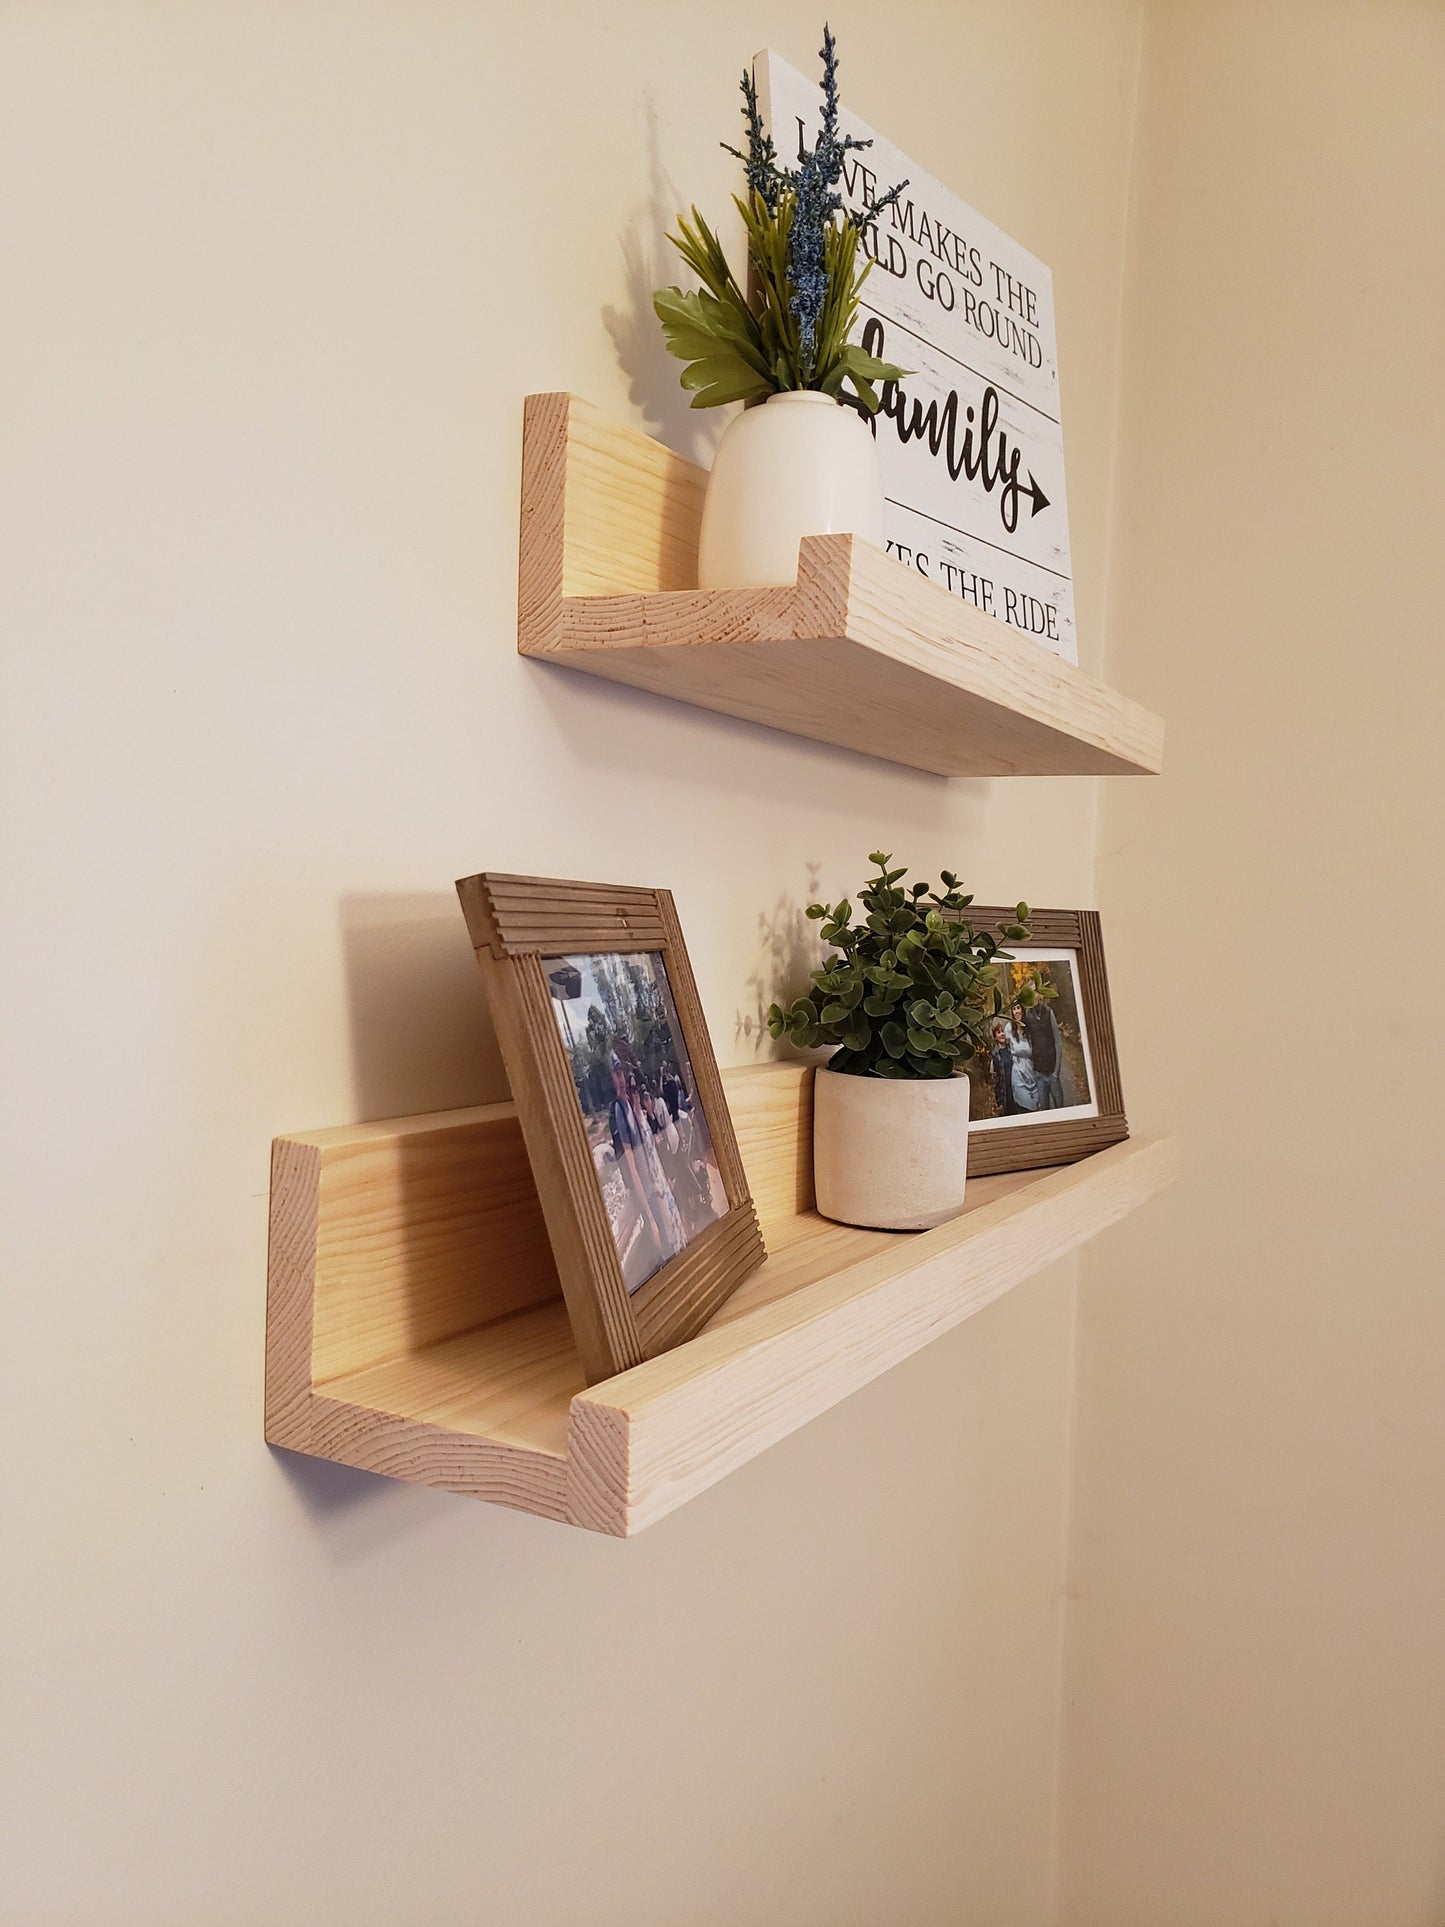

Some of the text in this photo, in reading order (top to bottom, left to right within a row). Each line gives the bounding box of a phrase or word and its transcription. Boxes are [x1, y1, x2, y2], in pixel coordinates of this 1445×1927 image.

[795, 116, 1040, 329] LVE MAKES THE
[916, 258, 956, 312] GO
[962, 287, 1043, 370] ROUND
[940, 561, 1060, 641] THE RIDE
